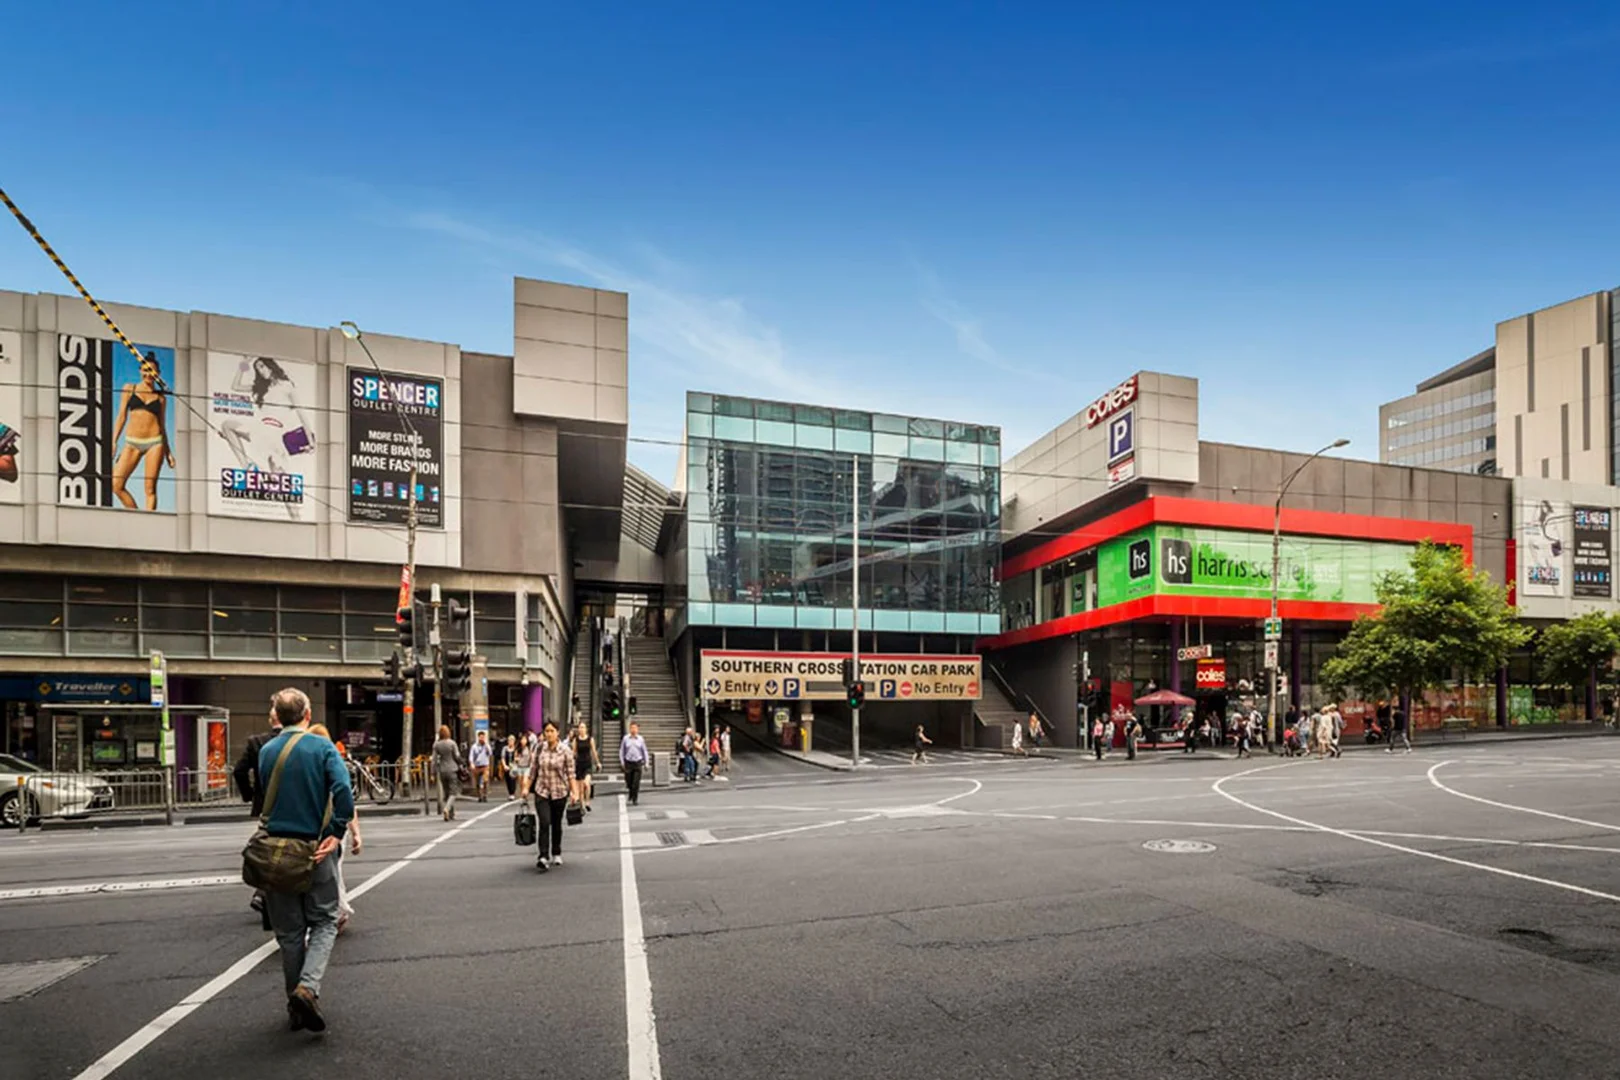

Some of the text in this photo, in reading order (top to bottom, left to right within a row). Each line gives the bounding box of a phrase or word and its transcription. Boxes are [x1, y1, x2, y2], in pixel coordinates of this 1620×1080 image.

[353, 377, 438, 407] SPENCER
[352, 398, 437, 417] OUTLET CENTRE
[1086, 378, 1135, 425] coles
[59, 334, 88, 506] BONDS
[368, 430, 423, 445] MORE STORS
[1113, 418, 1128, 454] P
[360, 442, 388, 455] MORE
[352, 455, 387, 470] MORE
[222, 470, 303, 493] SPENCER
[222, 488, 260, 499] OUTLET
[264, 492, 303, 504] CENTRE
[1133, 549, 1147, 571] hs
[1167, 548, 1186, 575] hs
[1198, 553, 1247, 579] harris
[711, 660, 976, 676] SOUTHERN CROSS TATION CAR PARK
[1196, 668, 1225, 682] coles
[724, 680, 760, 695] Entry
[786, 681, 798, 696] P
[883, 682, 893, 696] P
[915, 682, 965, 697] No Entry
